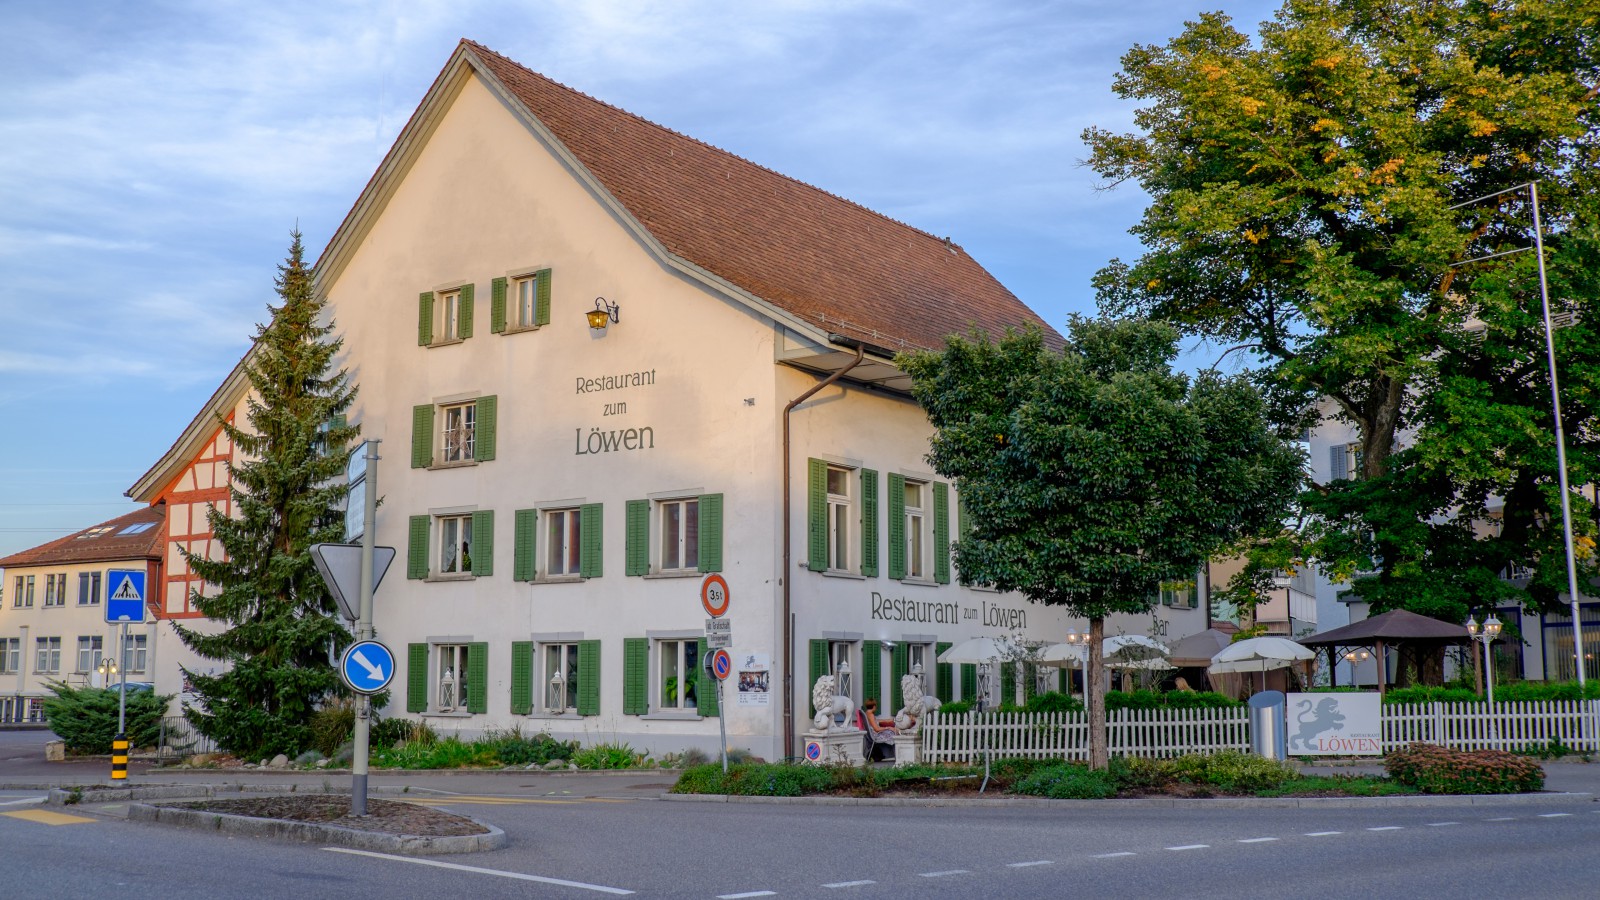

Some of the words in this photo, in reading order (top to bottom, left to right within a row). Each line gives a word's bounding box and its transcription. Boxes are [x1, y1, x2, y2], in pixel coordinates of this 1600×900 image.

[576, 368, 656, 395] Restaurant
[603, 402, 627, 416] zum
[575, 426, 655, 455] Löwen
[871, 592, 959, 625] Restaurant
[963, 607, 978, 620] zum
[982, 600, 1027, 629] Löwen
[1153, 614, 1170, 637] Bar
[1319, 735, 1380, 751] LÖWEN
